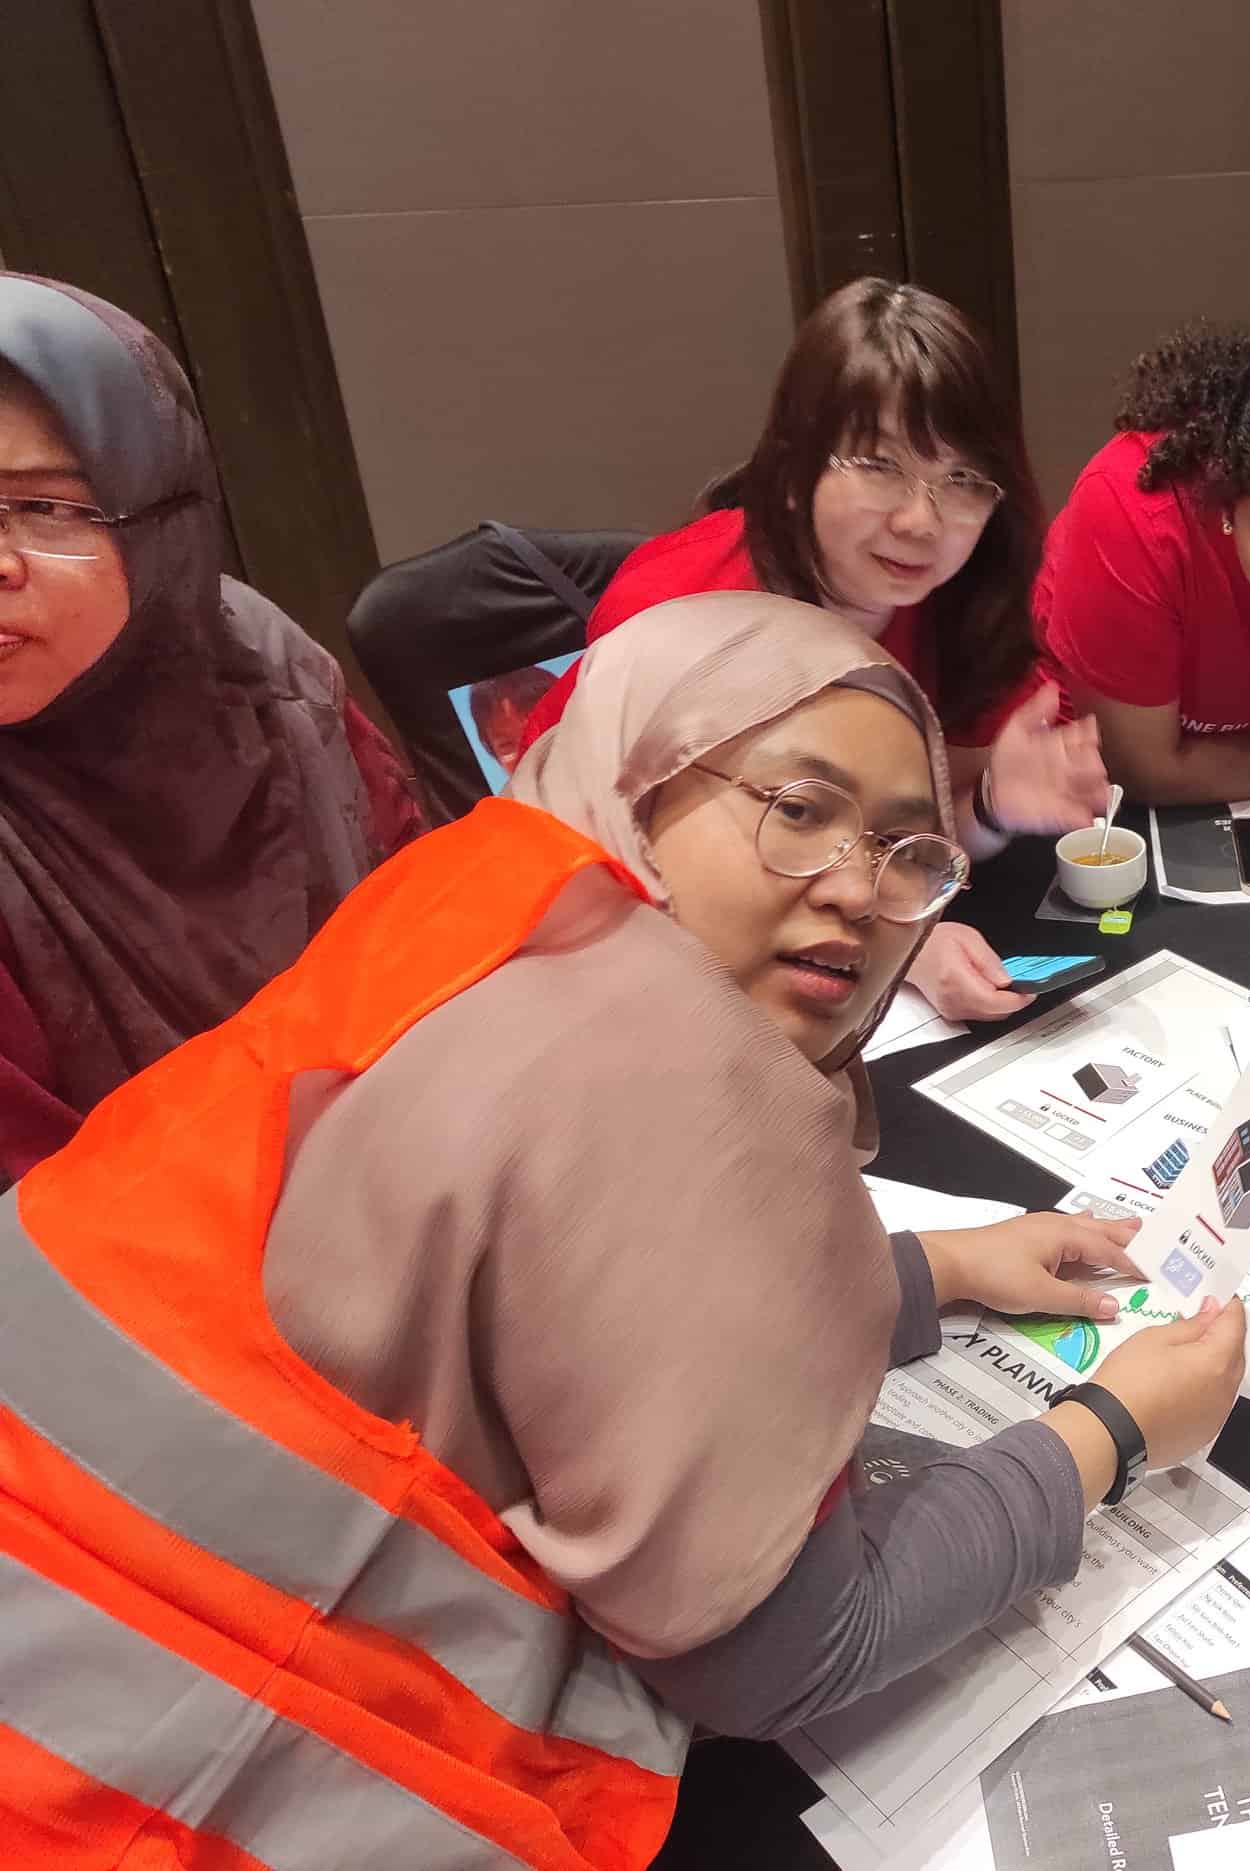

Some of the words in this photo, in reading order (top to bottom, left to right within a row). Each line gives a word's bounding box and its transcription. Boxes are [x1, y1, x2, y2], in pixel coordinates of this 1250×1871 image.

[1121, 1047, 1166, 1068] FACTORY
[1051, 1109, 1081, 1126] LOCKED
[1163, 1112, 1209, 1135] BUSINES
[1129, 1199, 1156, 1213] LOCKE
[1189, 1239, 1216, 1271] LOCKED
[981, 1345, 1056, 1404] PLANN
[932, 1377, 958, 1397] PHASE
[963, 1398, 1000, 1425] TRADING
[1108, 1503, 1153, 1541] BUILDING
[1099, 1801, 1125, 1857] Detailed
